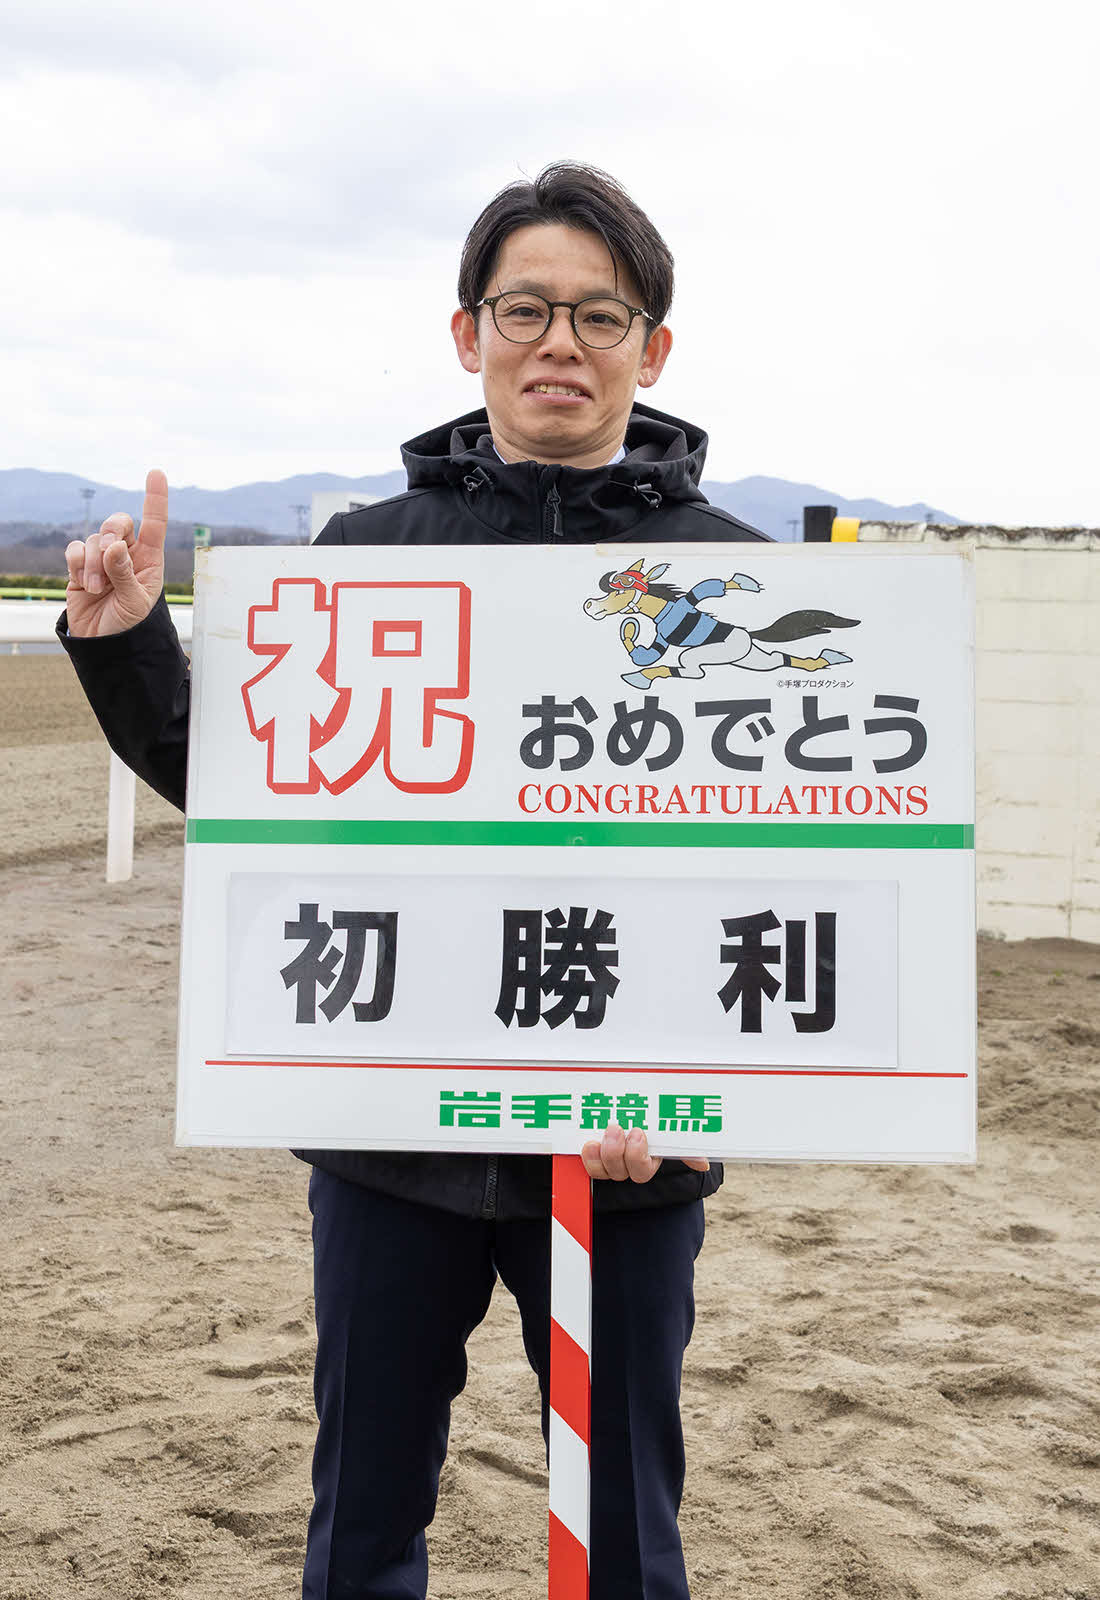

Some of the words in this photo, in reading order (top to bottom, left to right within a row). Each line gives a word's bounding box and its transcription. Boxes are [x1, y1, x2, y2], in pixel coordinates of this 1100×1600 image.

[241, 578, 475, 796] 祝
[520, 695, 927, 773] おめでとう
[518, 784, 928, 815] CONGRATULATIONS
[440, 1091, 722, 1132] 岩手競馬
